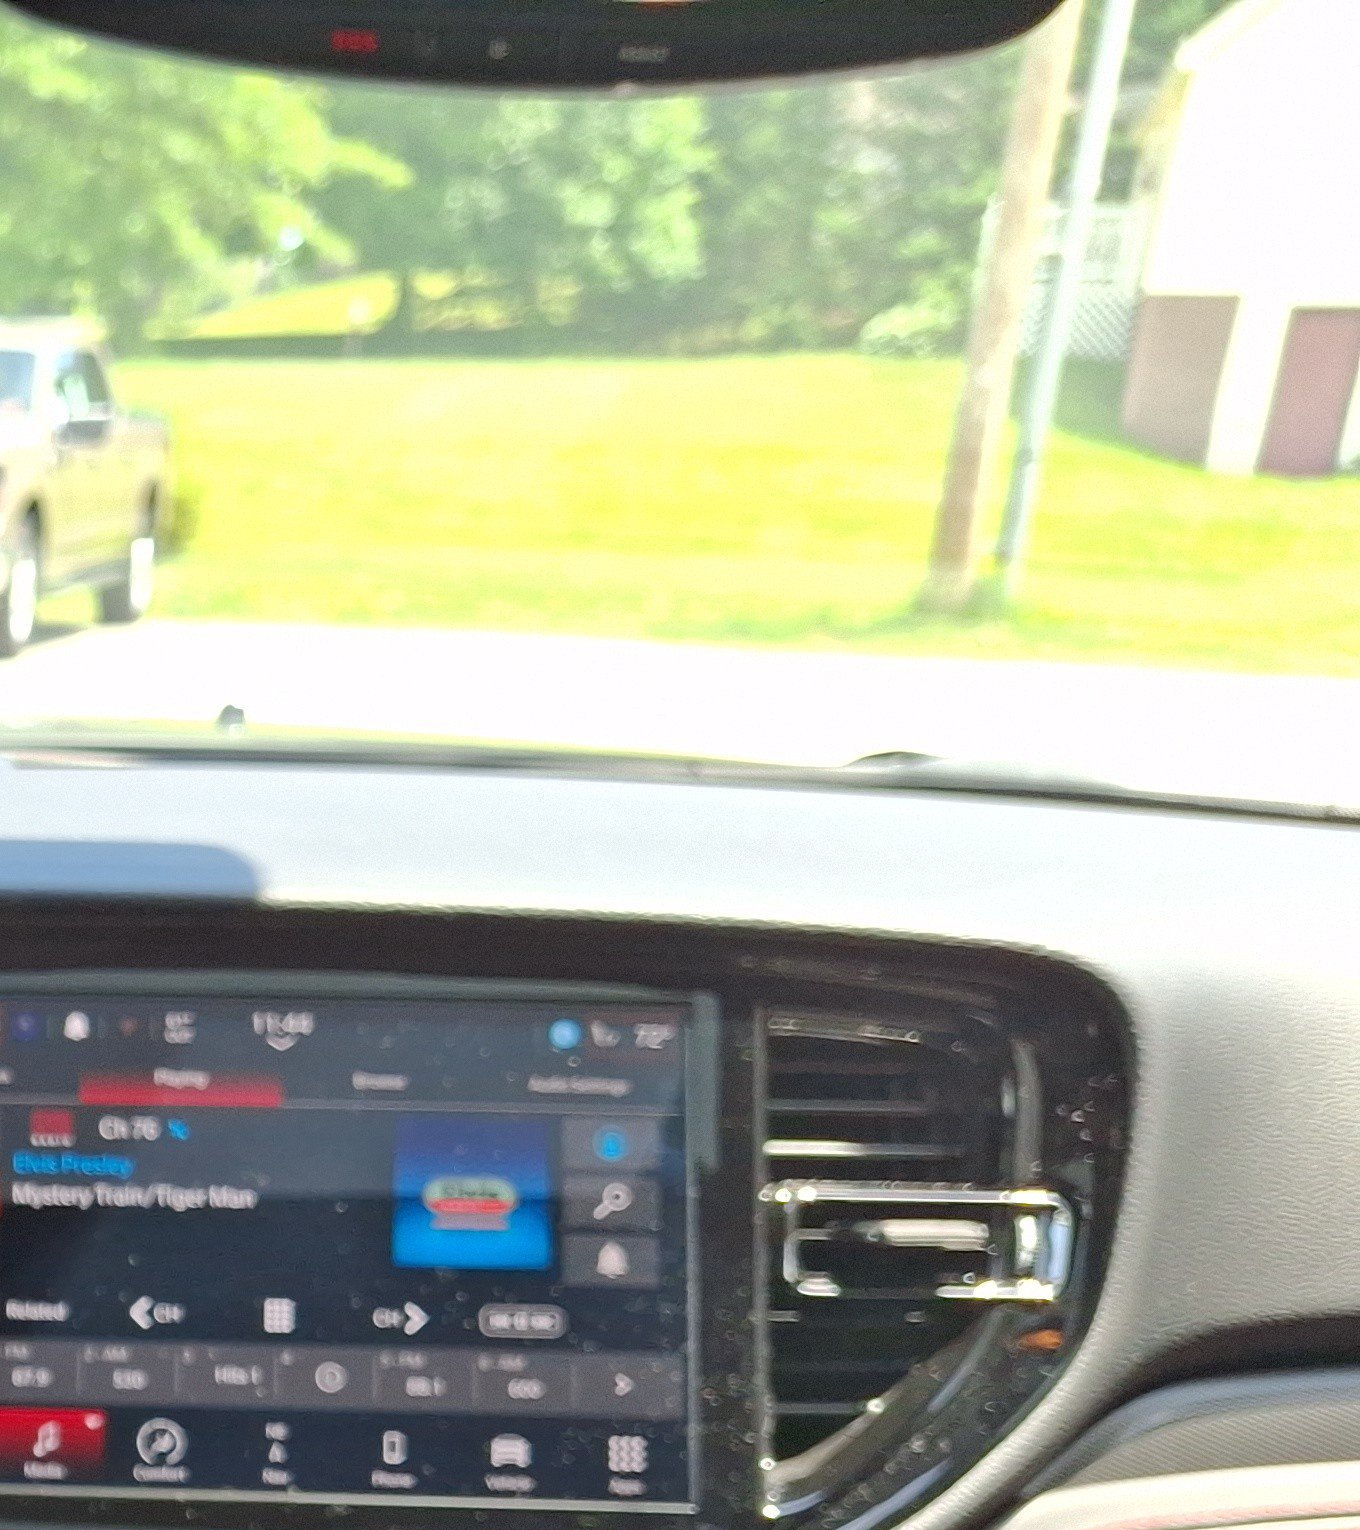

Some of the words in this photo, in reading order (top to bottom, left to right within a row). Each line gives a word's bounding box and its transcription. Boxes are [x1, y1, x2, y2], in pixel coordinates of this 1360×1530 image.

[12, 1150, 60, 1176] Elvis
[61, 1151, 135, 1181] Presley
[12, 1181, 94, 1211] Mystery
[93, 1182, 207, 1212] Train/Tiger
[208, 1185, 260, 1210] Man
